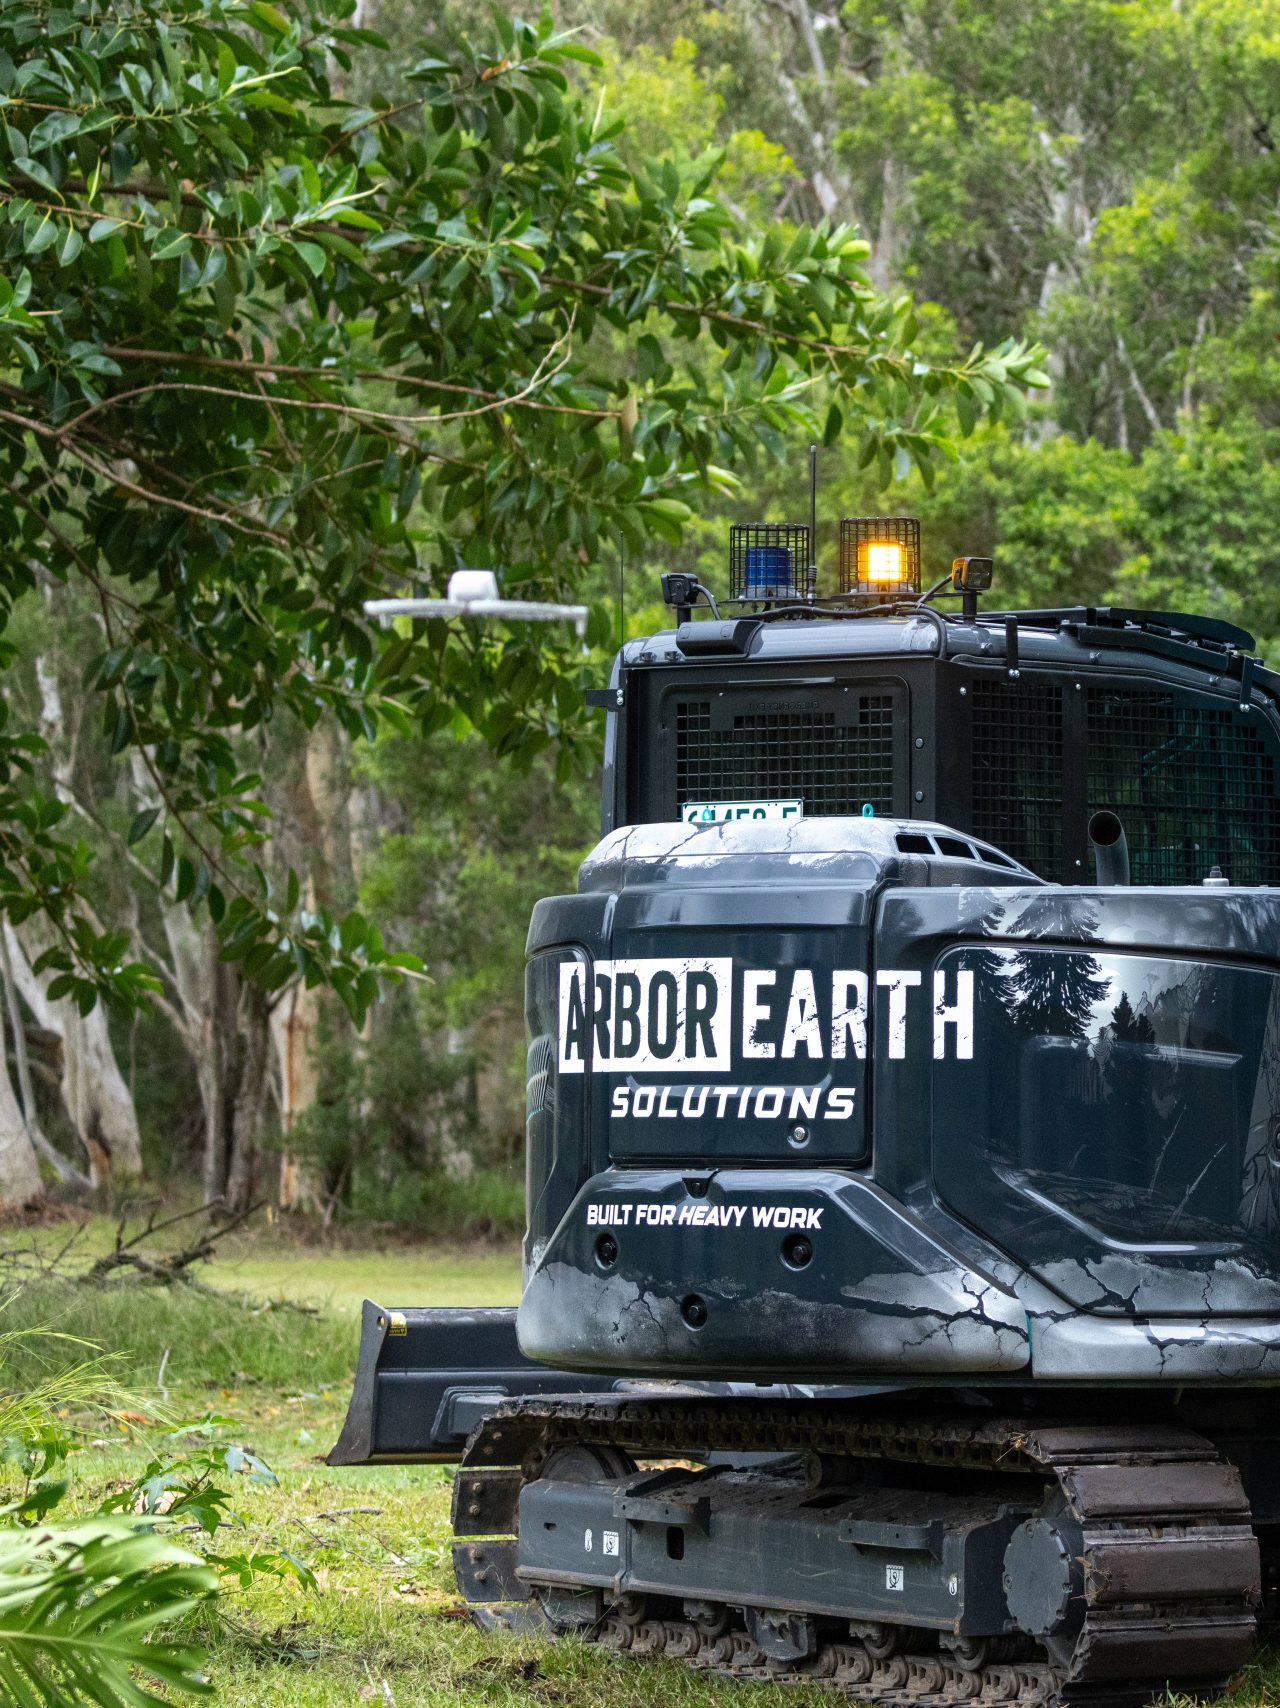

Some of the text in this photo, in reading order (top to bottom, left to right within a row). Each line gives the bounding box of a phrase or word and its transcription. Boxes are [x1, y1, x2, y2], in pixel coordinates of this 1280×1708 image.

[565, 968, 974, 1060] ARBOR EARTH
[611, 1086, 856, 1120] SOLUTIONS
[587, 1204, 824, 1229] BUILT FOR HEAVY WORK
